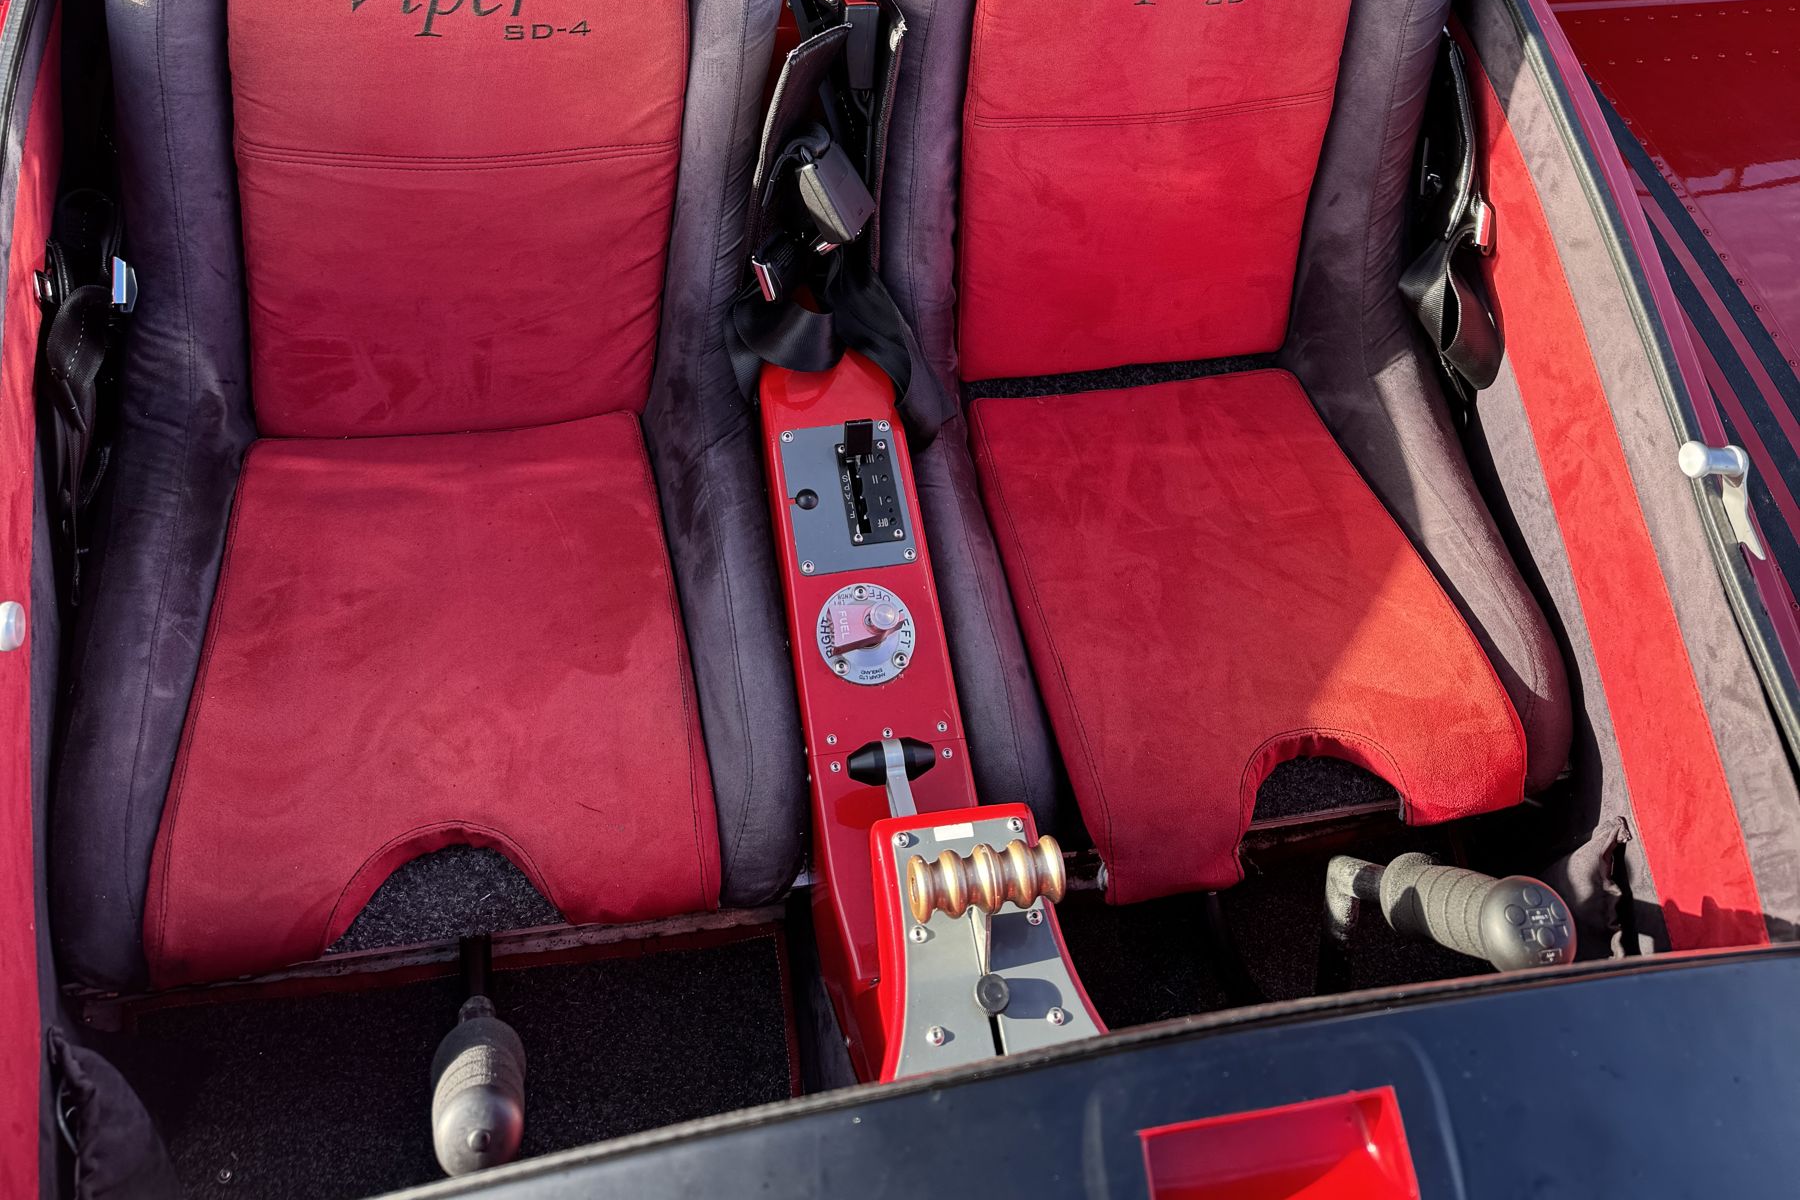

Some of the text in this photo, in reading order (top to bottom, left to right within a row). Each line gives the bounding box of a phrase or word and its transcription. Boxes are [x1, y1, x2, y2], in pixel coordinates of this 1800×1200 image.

[503, 20, 592, 41] SD-4
[841, 474, 856, 519] FLAPS
[877, 517, 889, 528] OFF
[868, 589, 891, 602] OFF
[820, 616, 833, 659] RIGHT
[838, 610, 851, 640] FUEL
